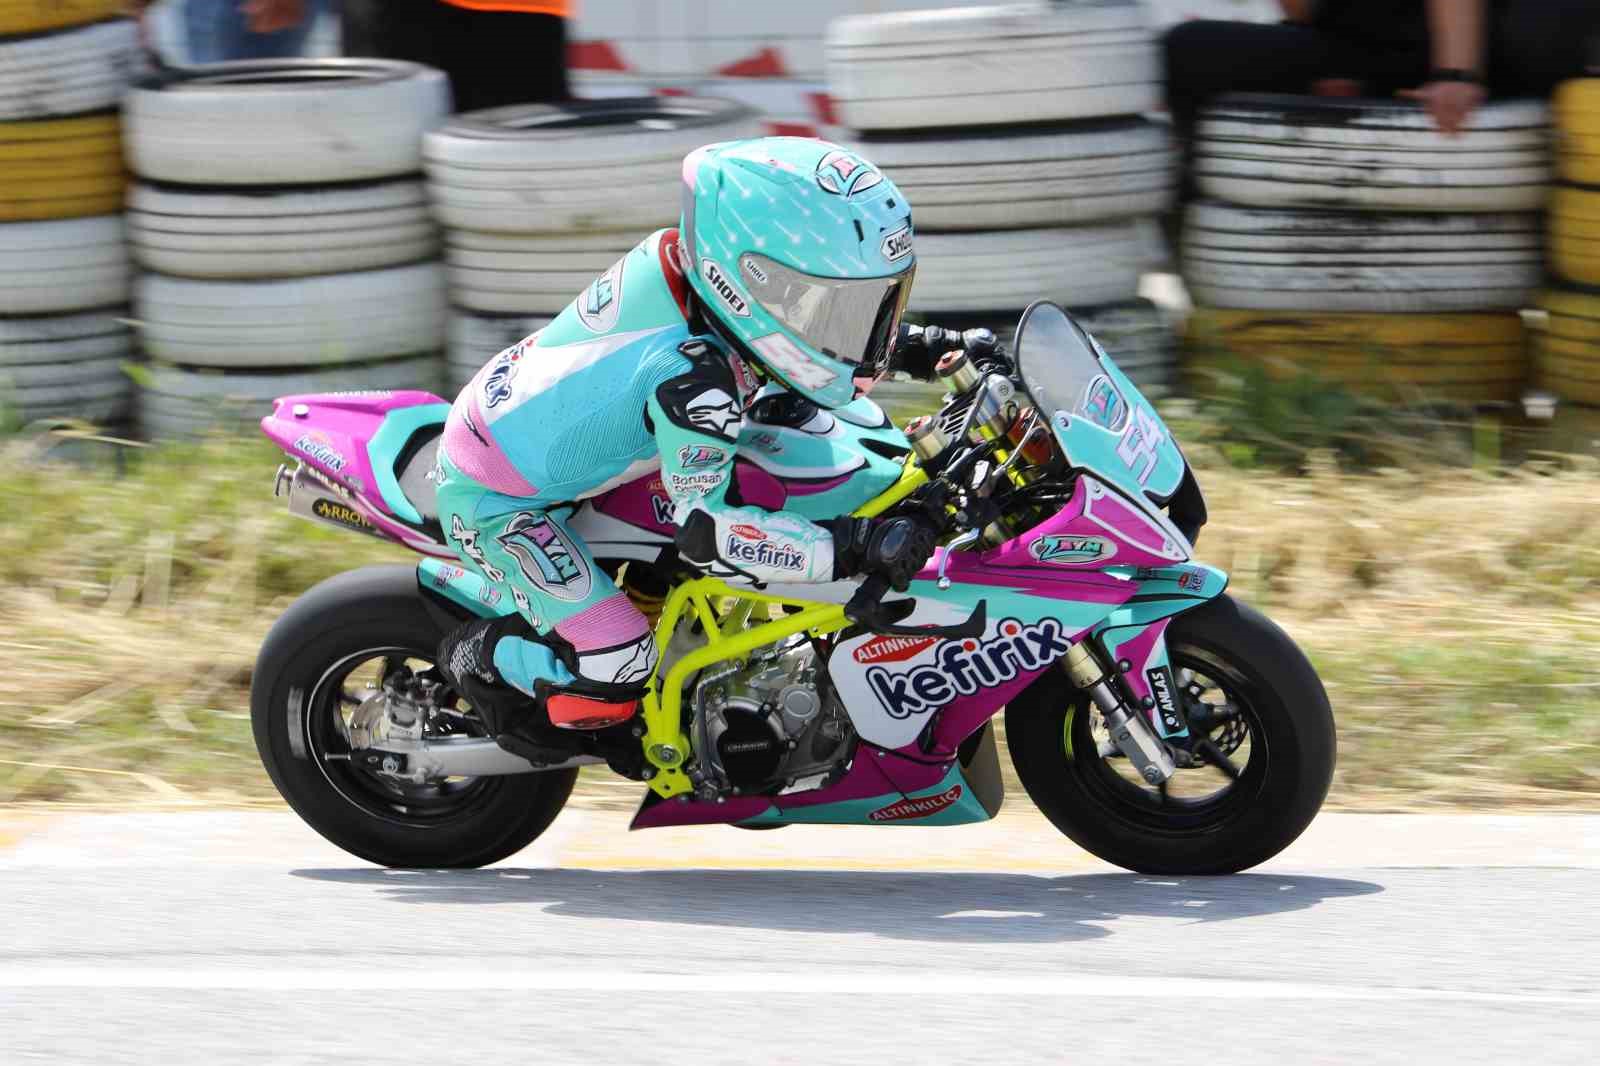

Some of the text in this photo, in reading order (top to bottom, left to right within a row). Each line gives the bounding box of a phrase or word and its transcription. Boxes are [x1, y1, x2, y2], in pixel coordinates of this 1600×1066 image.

[704, 265, 745, 313] SHOEI
[1116, 402, 1166, 486] 54
[672, 473, 722, 485] Borusan
[726, 533, 808, 570] kefirix
[865, 617, 1073, 720] kefirix
[1151, 672, 1176, 712] ANLAS
